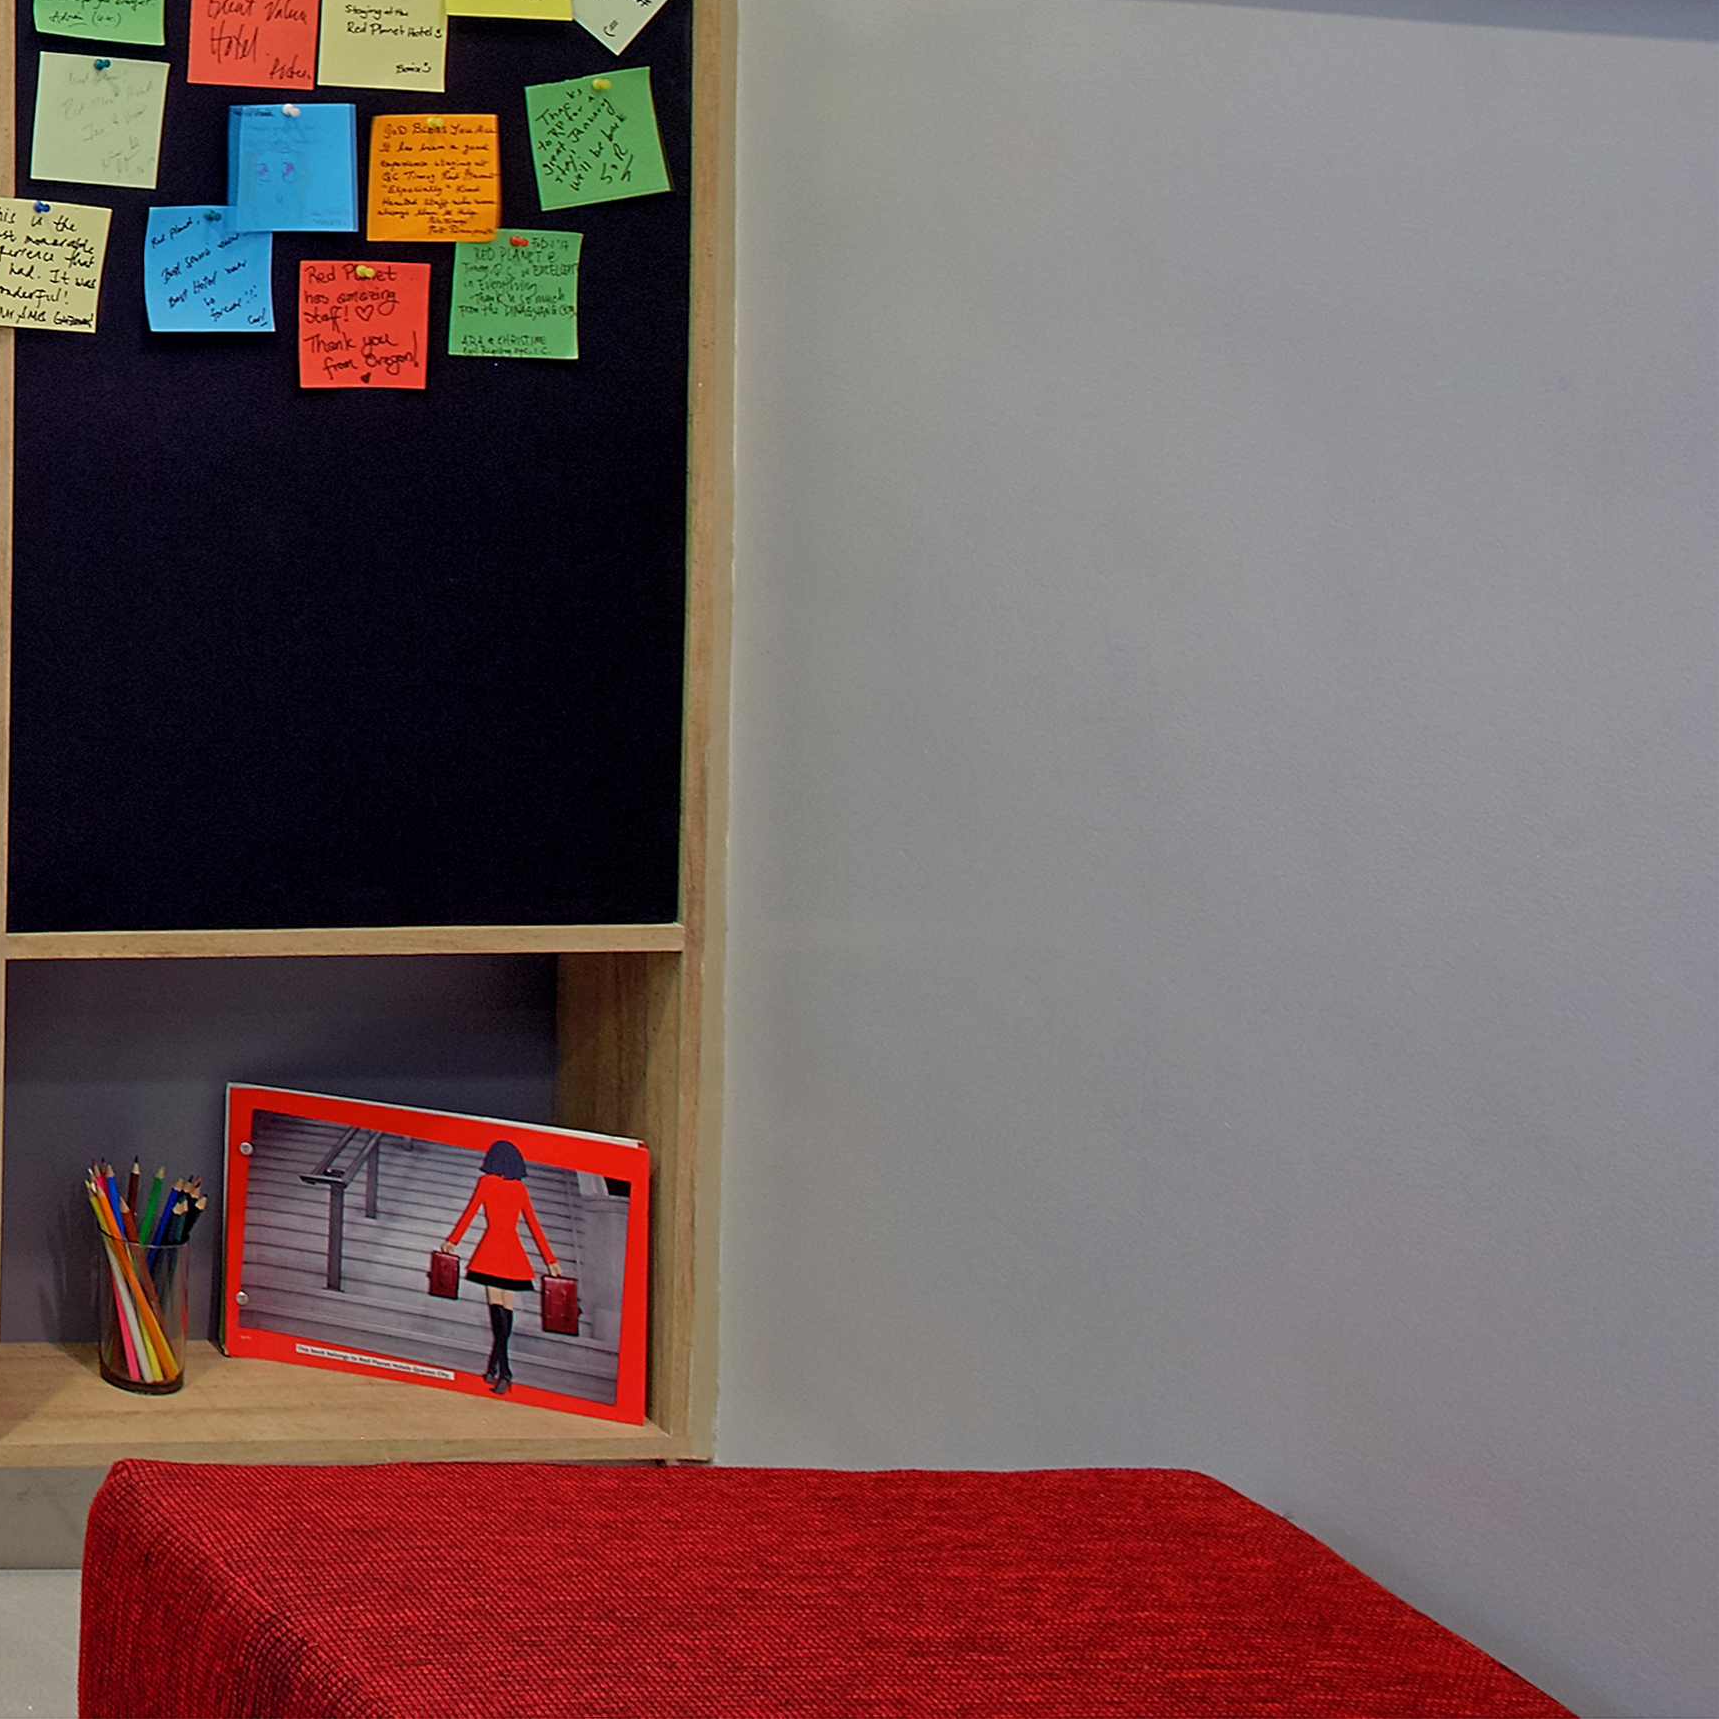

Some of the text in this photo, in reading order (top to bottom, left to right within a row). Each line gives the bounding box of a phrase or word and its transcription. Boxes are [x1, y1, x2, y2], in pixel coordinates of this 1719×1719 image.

[304, 289, 400, 315] has amazing
[304, 306, 349, 333] staff!
[304, 333, 398, 358] Thank you
[324, 355, 357, 381] from
